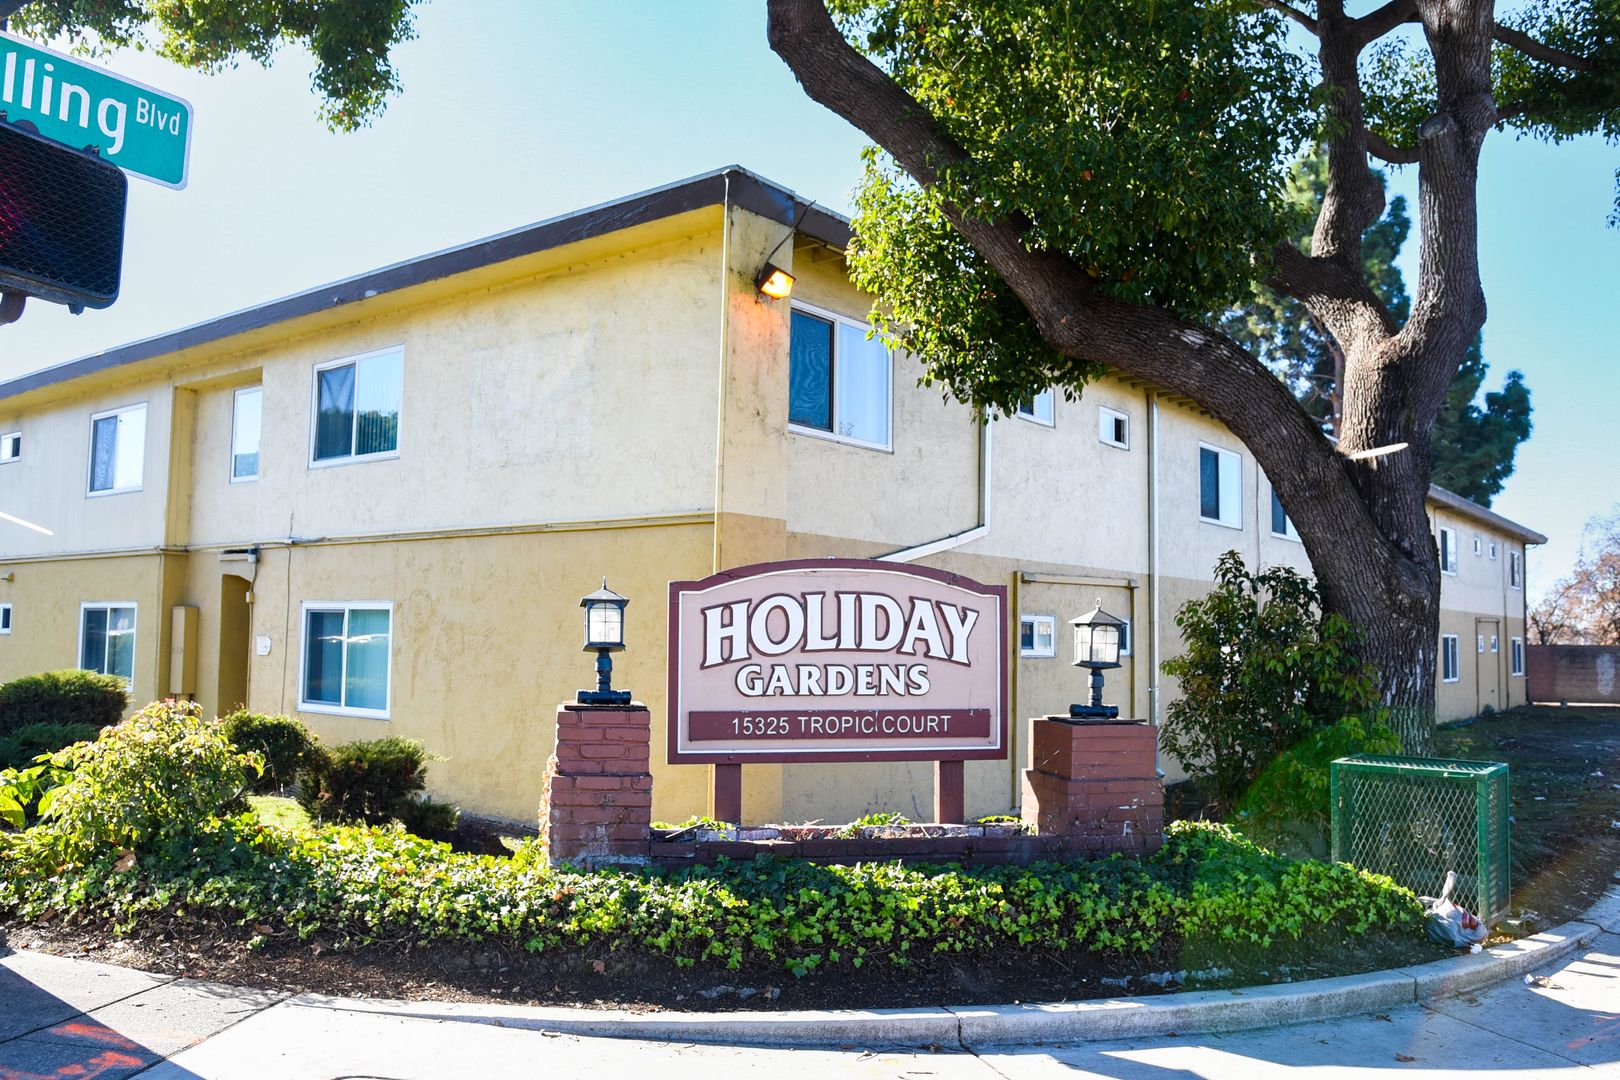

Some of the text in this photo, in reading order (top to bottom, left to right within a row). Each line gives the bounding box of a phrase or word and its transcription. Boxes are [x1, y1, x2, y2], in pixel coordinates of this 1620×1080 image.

[136, 97, 180, 136] Blvd
[701, 591, 979, 669] HOLIDAY
[735, 664, 930, 696] GARDENS
[732, 715, 951, 735] 15325 TROPIC COURT
